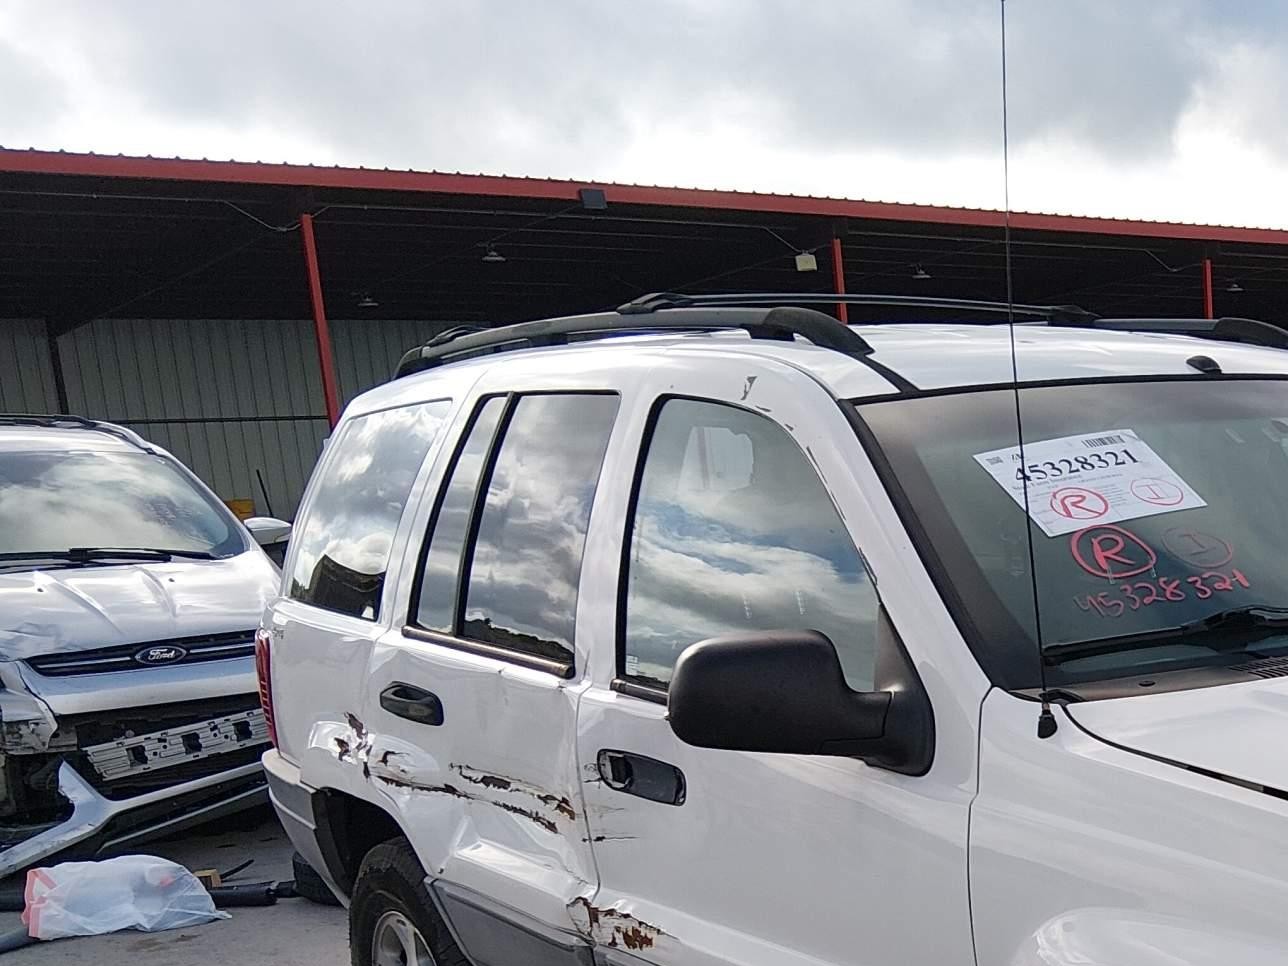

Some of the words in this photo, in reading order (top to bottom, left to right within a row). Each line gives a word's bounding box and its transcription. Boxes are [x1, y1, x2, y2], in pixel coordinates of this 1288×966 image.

[1015, 448, 1141, 482] 45328321
[1061, 494, 1103, 518] R
[1091, 533, 1137, 570] R
[147, 648, 176, 661] Ford
